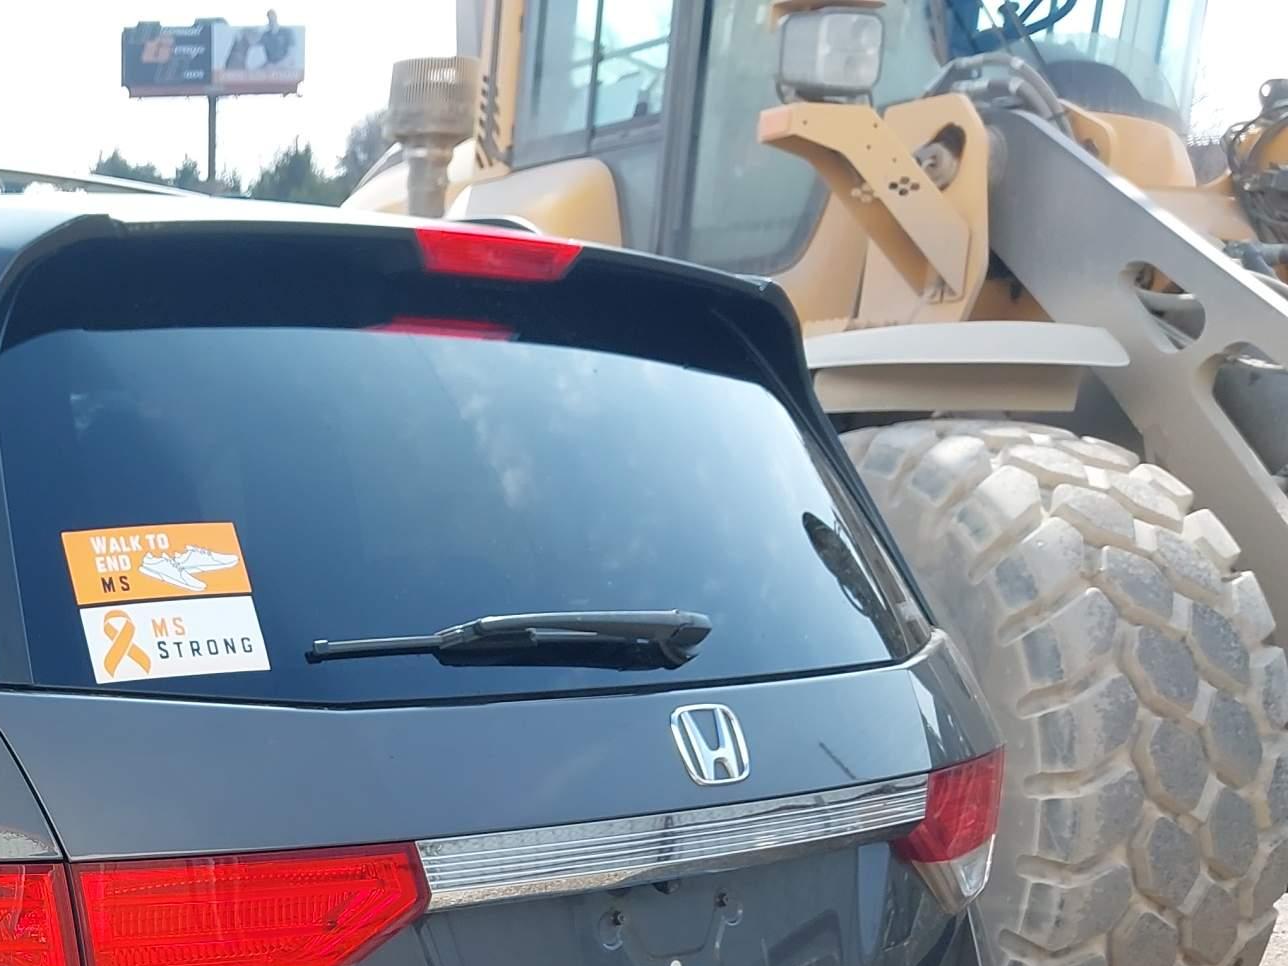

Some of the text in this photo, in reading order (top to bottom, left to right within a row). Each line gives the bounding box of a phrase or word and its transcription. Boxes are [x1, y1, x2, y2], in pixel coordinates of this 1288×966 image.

[89, 533, 170, 554] WALK TO
[95, 555, 132, 574] END
[157, 637, 253, 659] STRONG
